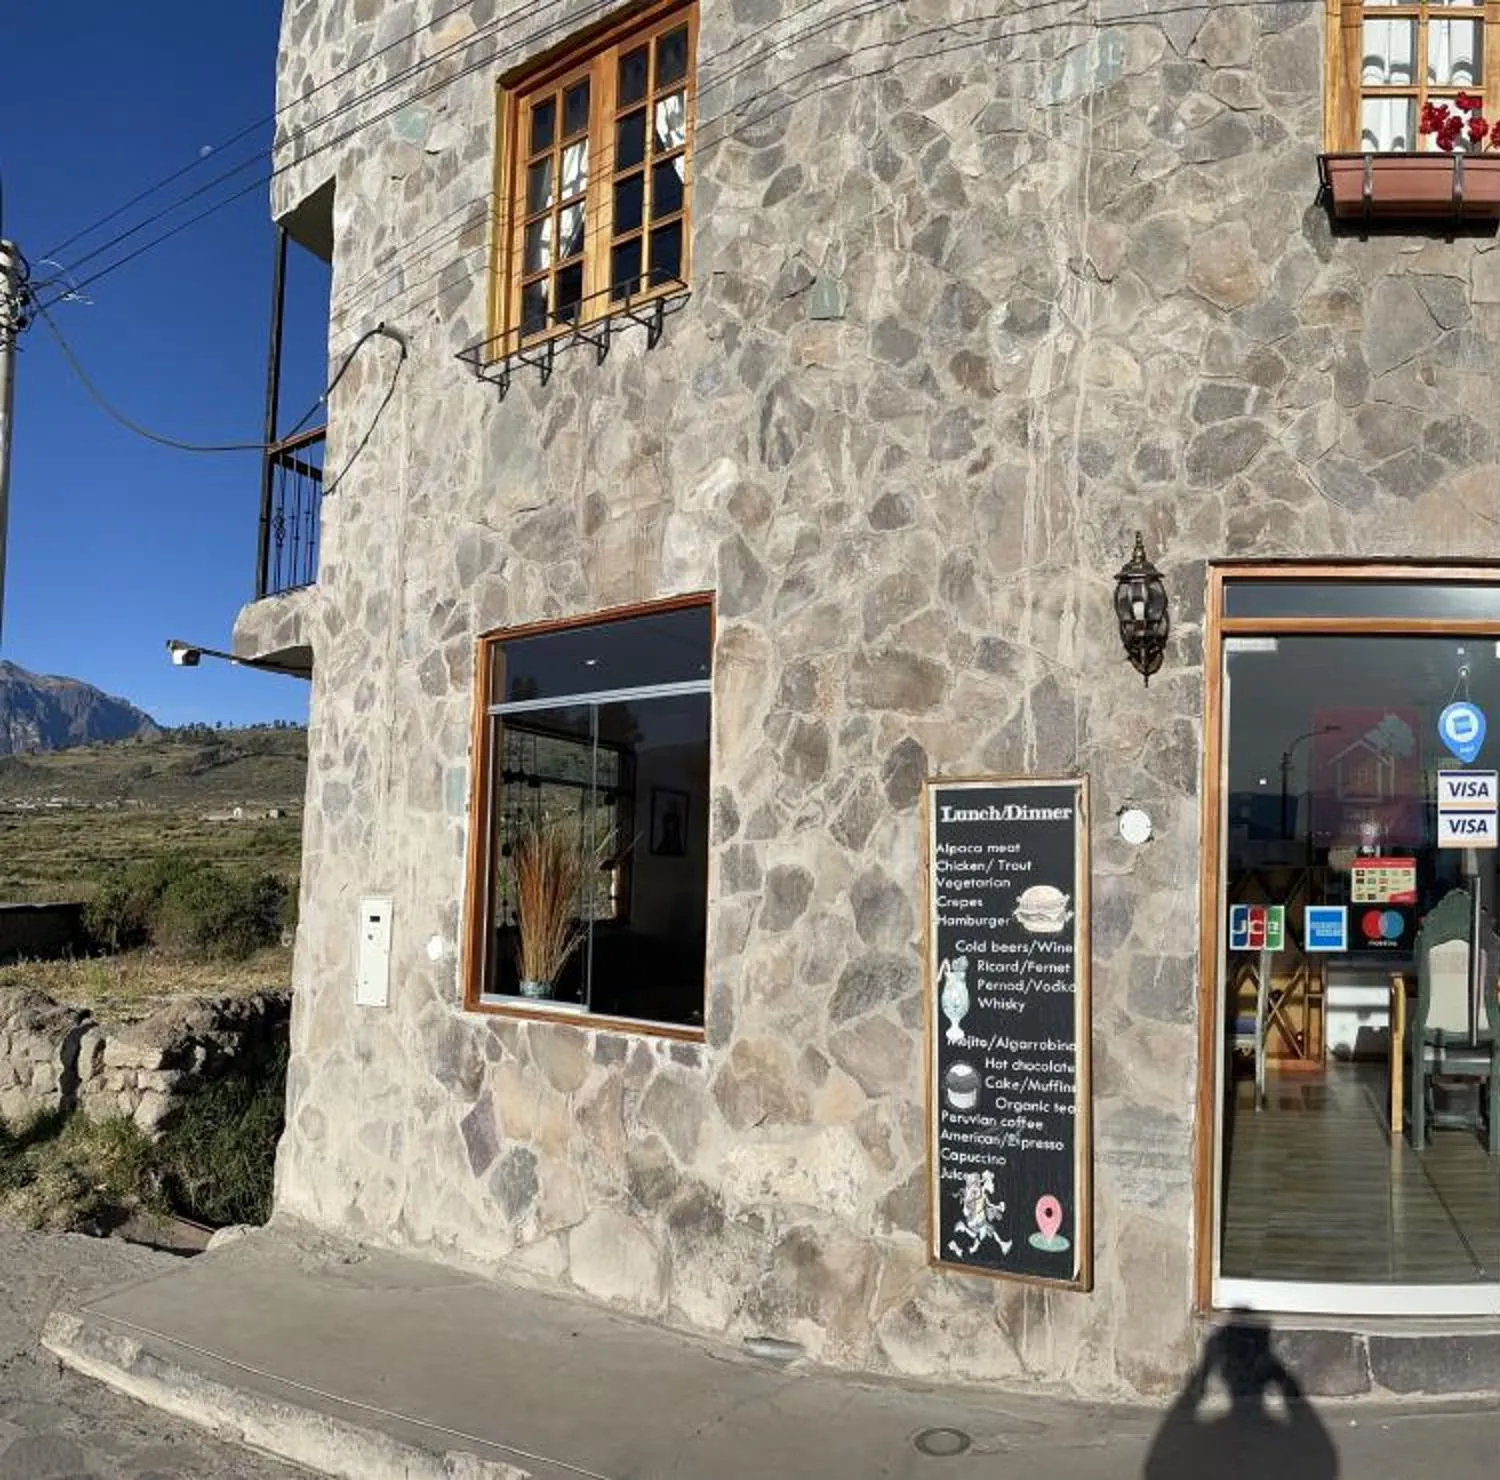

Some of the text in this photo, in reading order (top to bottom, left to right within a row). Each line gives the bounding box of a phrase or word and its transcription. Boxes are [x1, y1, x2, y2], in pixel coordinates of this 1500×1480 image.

[1448, 781, 1489, 797] VISA
[940, 804, 1073, 823] Lunch/Dinner
[1448, 819, 1488, 834] VISA
[936, 843, 1021, 857] Alpaca meat
[998, 859, 1032, 871] Trout
[936, 876, 1011, 891] Vegetarian
[936, 895, 983, 910] Crepes
[936, 914, 1012, 929] Hamburger
[955, 939, 987, 953] Cold
[977, 959, 1071, 975] Ricard/Fernet
[977, 978, 1077, 995] Pernod/Vodka
[977, 997, 1026, 1012] Whisky
[985, 1056, 1009, 1070] Hot
[995, 1097, 1050, 1115] Organic
[941, 1109, 1044, 1130] Peruvian coffee
